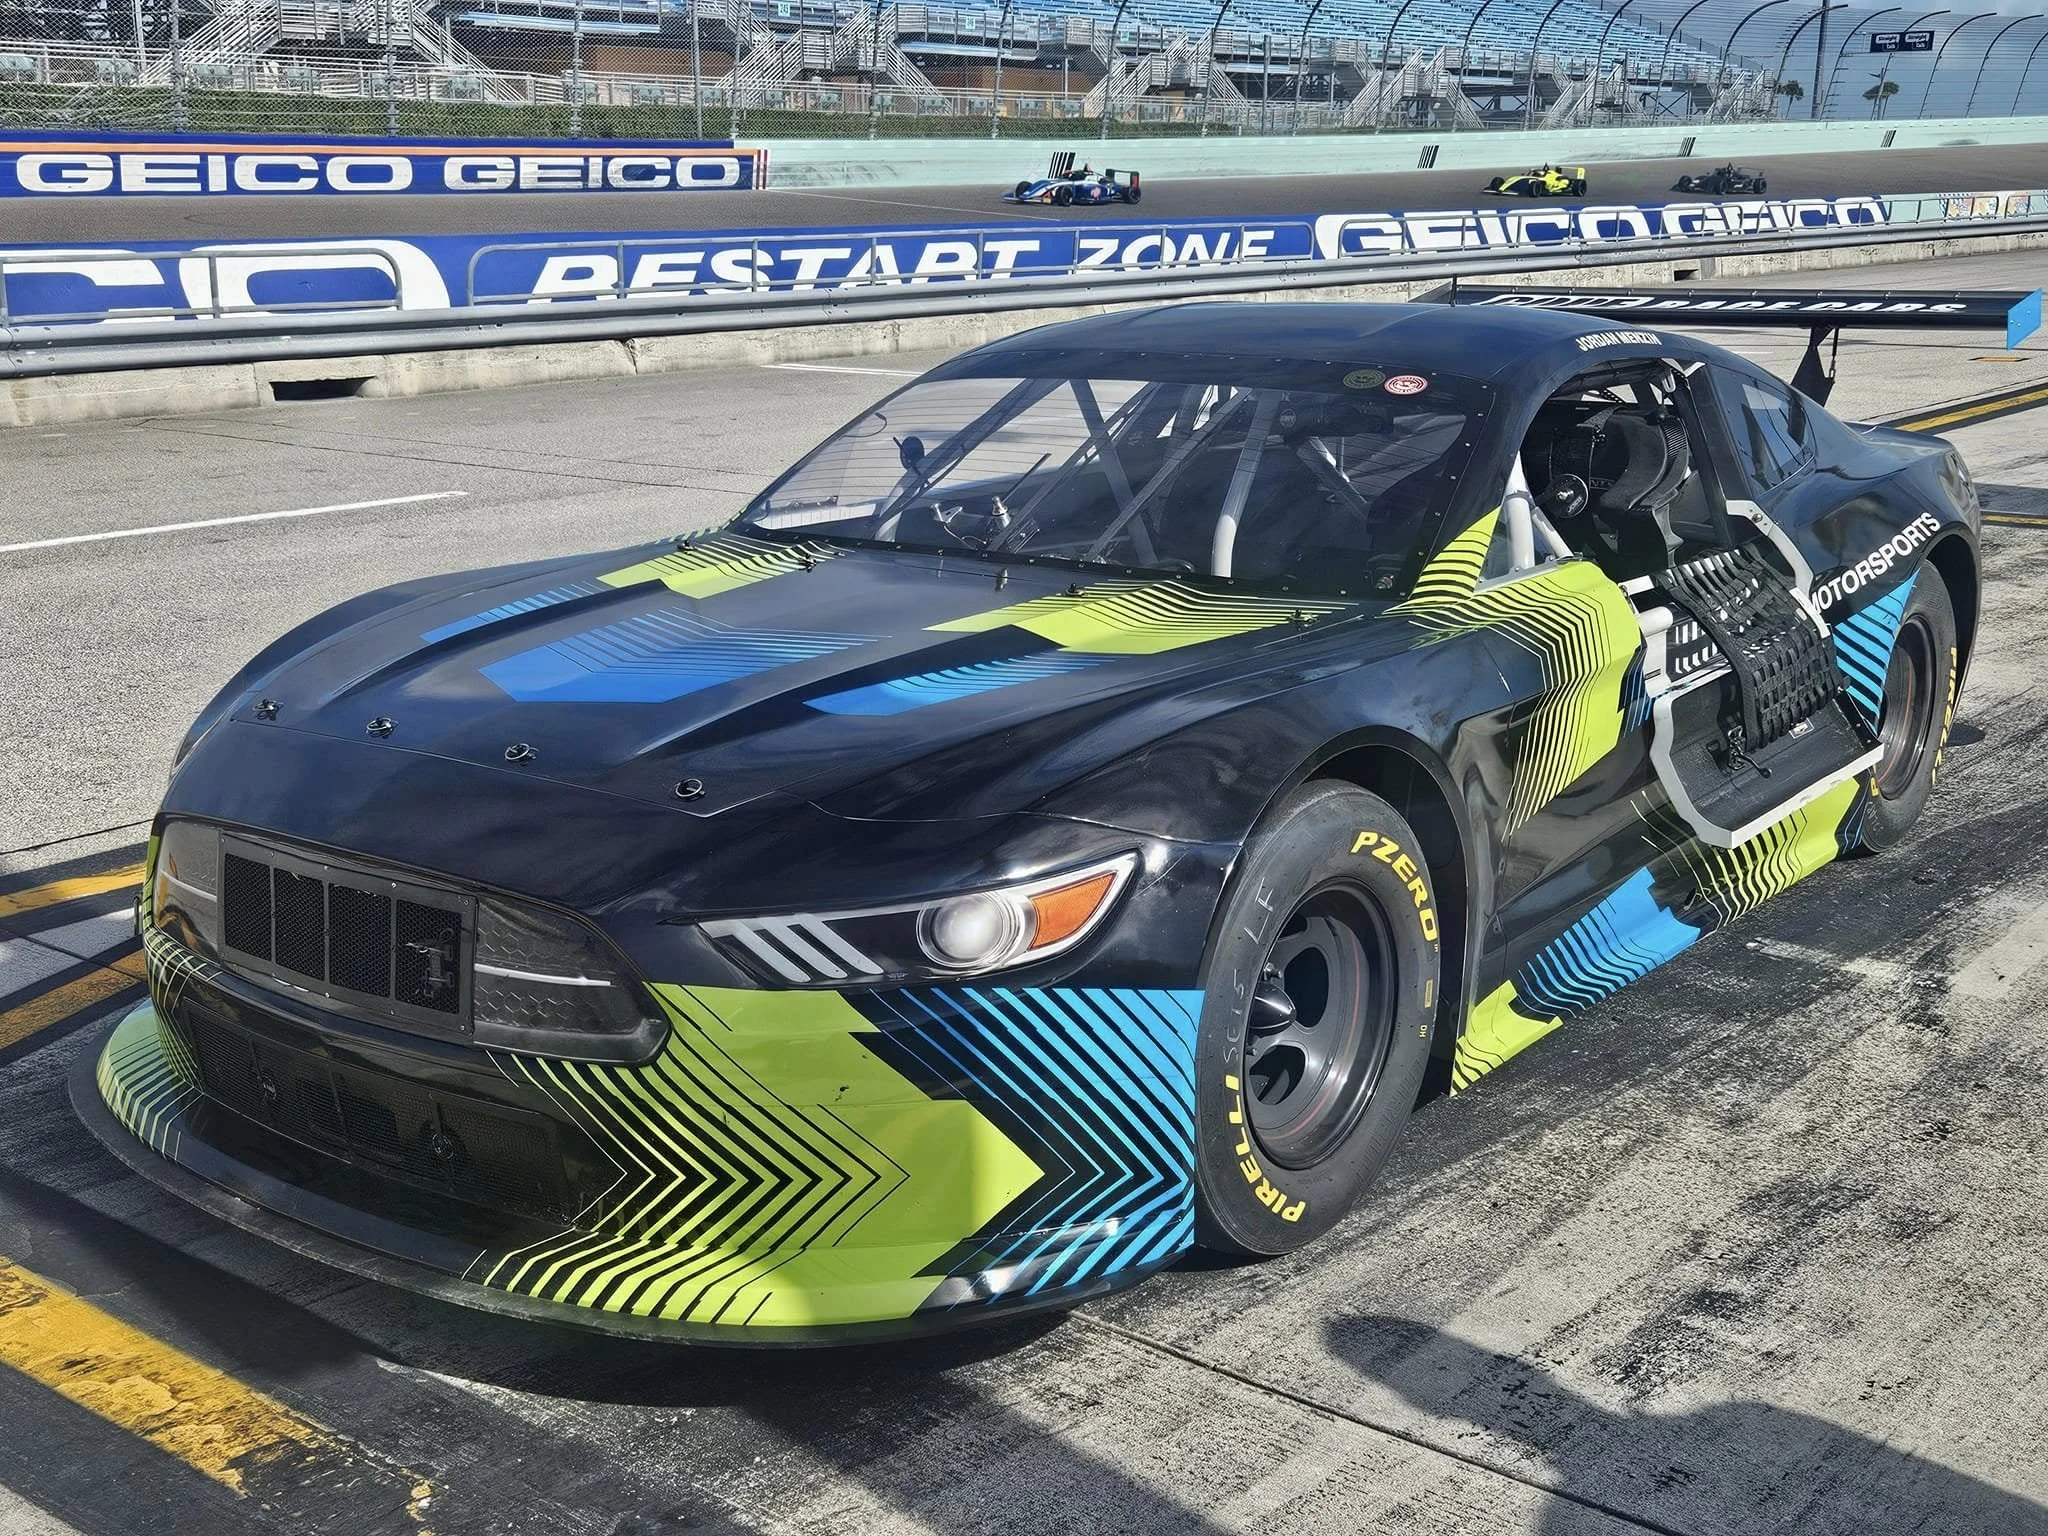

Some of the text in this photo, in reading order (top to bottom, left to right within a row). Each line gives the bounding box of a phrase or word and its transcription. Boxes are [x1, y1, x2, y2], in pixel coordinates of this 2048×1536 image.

[16, 153, 740, 193] GEICO GEICO
[1314, 196, 1886, 260] GEICO GEICO
[527, 230, 1275, 305] RESTART ZONE
[1640, 300, 1801, 311] RACE
[1799, 302, 1967, 313] CARS
[1576, 331, 1621, 352] JORDAN
[1350, 831, 1438, 941] PZERO
[1225, 1074, 1306, 1222] PIRELLI
